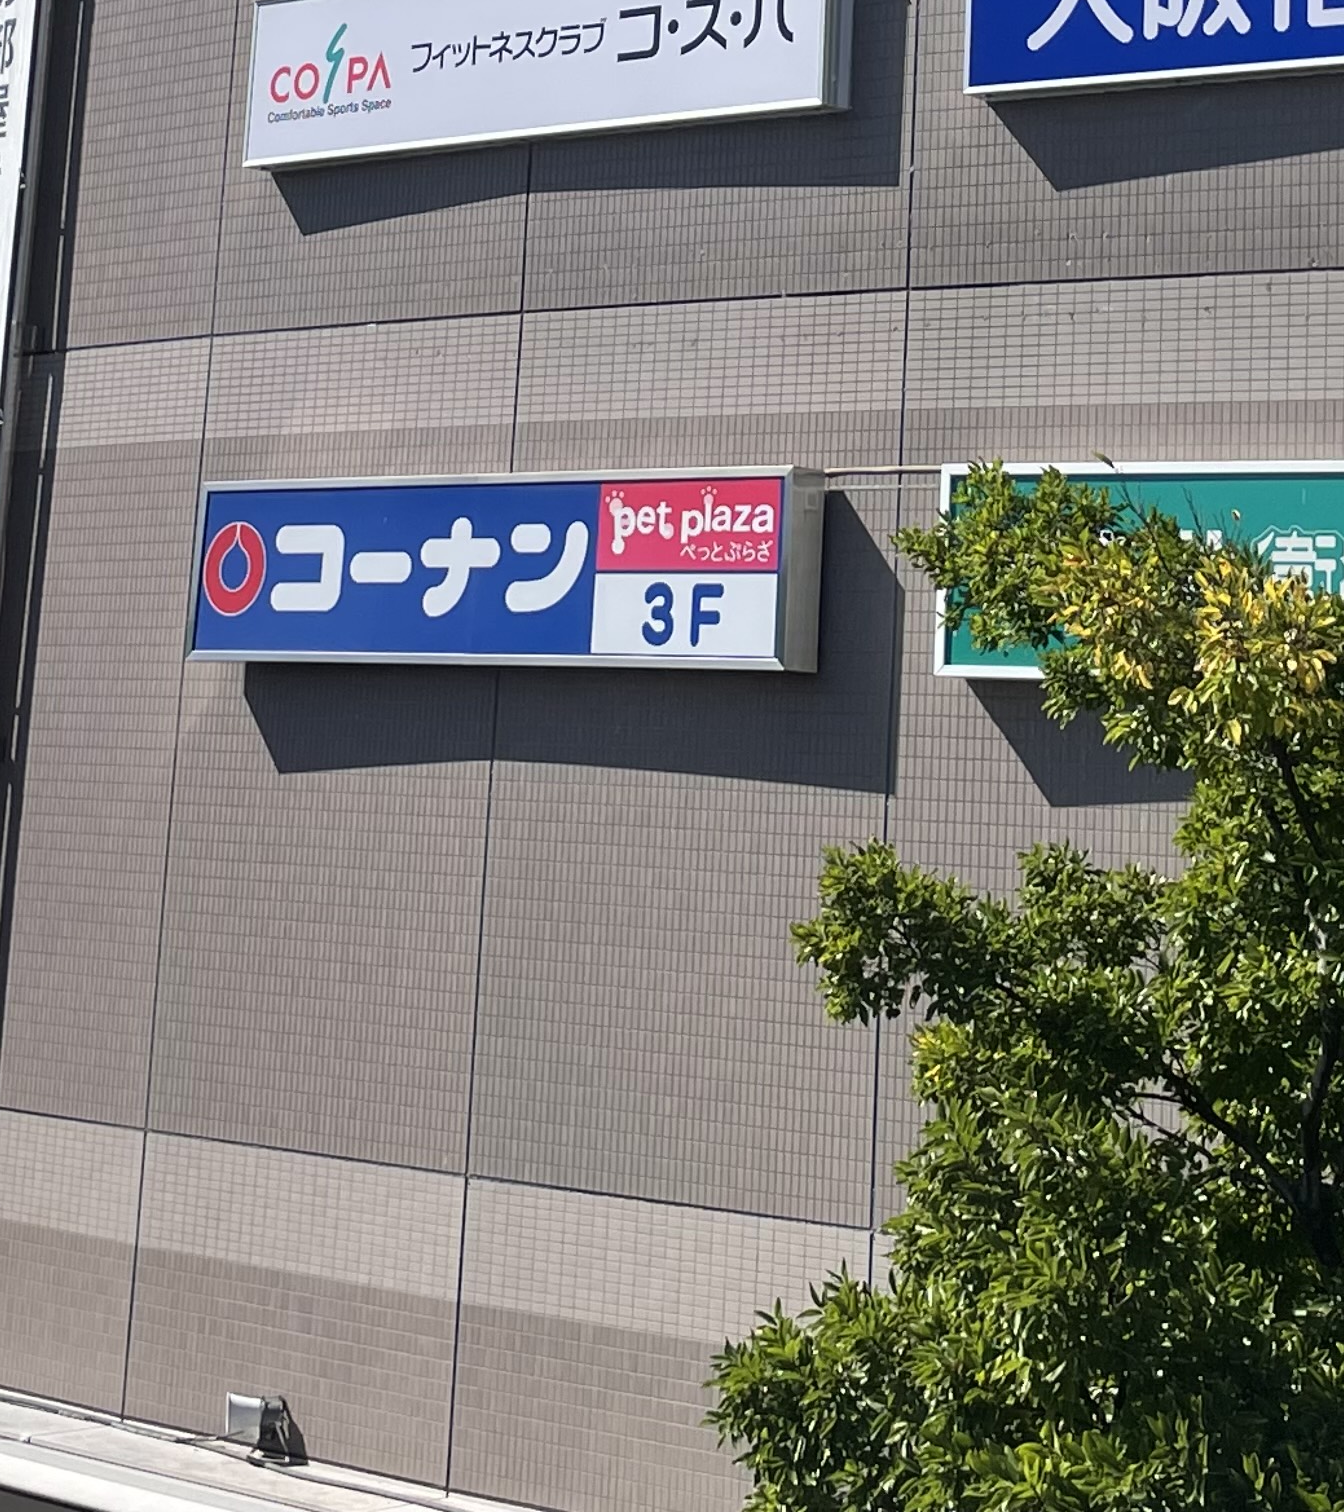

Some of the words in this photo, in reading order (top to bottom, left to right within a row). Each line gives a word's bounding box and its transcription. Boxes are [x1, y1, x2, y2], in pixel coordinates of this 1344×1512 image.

[410, 16, 609, 76] フィットネスクラブ
[267, 106, 325, 124] Comfortable
[327, 101, 360, 118] Sports
[361, 98, 392, 115] Space
[607, 491, 675, 555] pet
[680, 488, 775, 544] plaza
[679, 539, 774, 563] ぺっとぷらざ
[270, 516, 590, 618] コーナン
[641, 581, 725, 648] 3F
